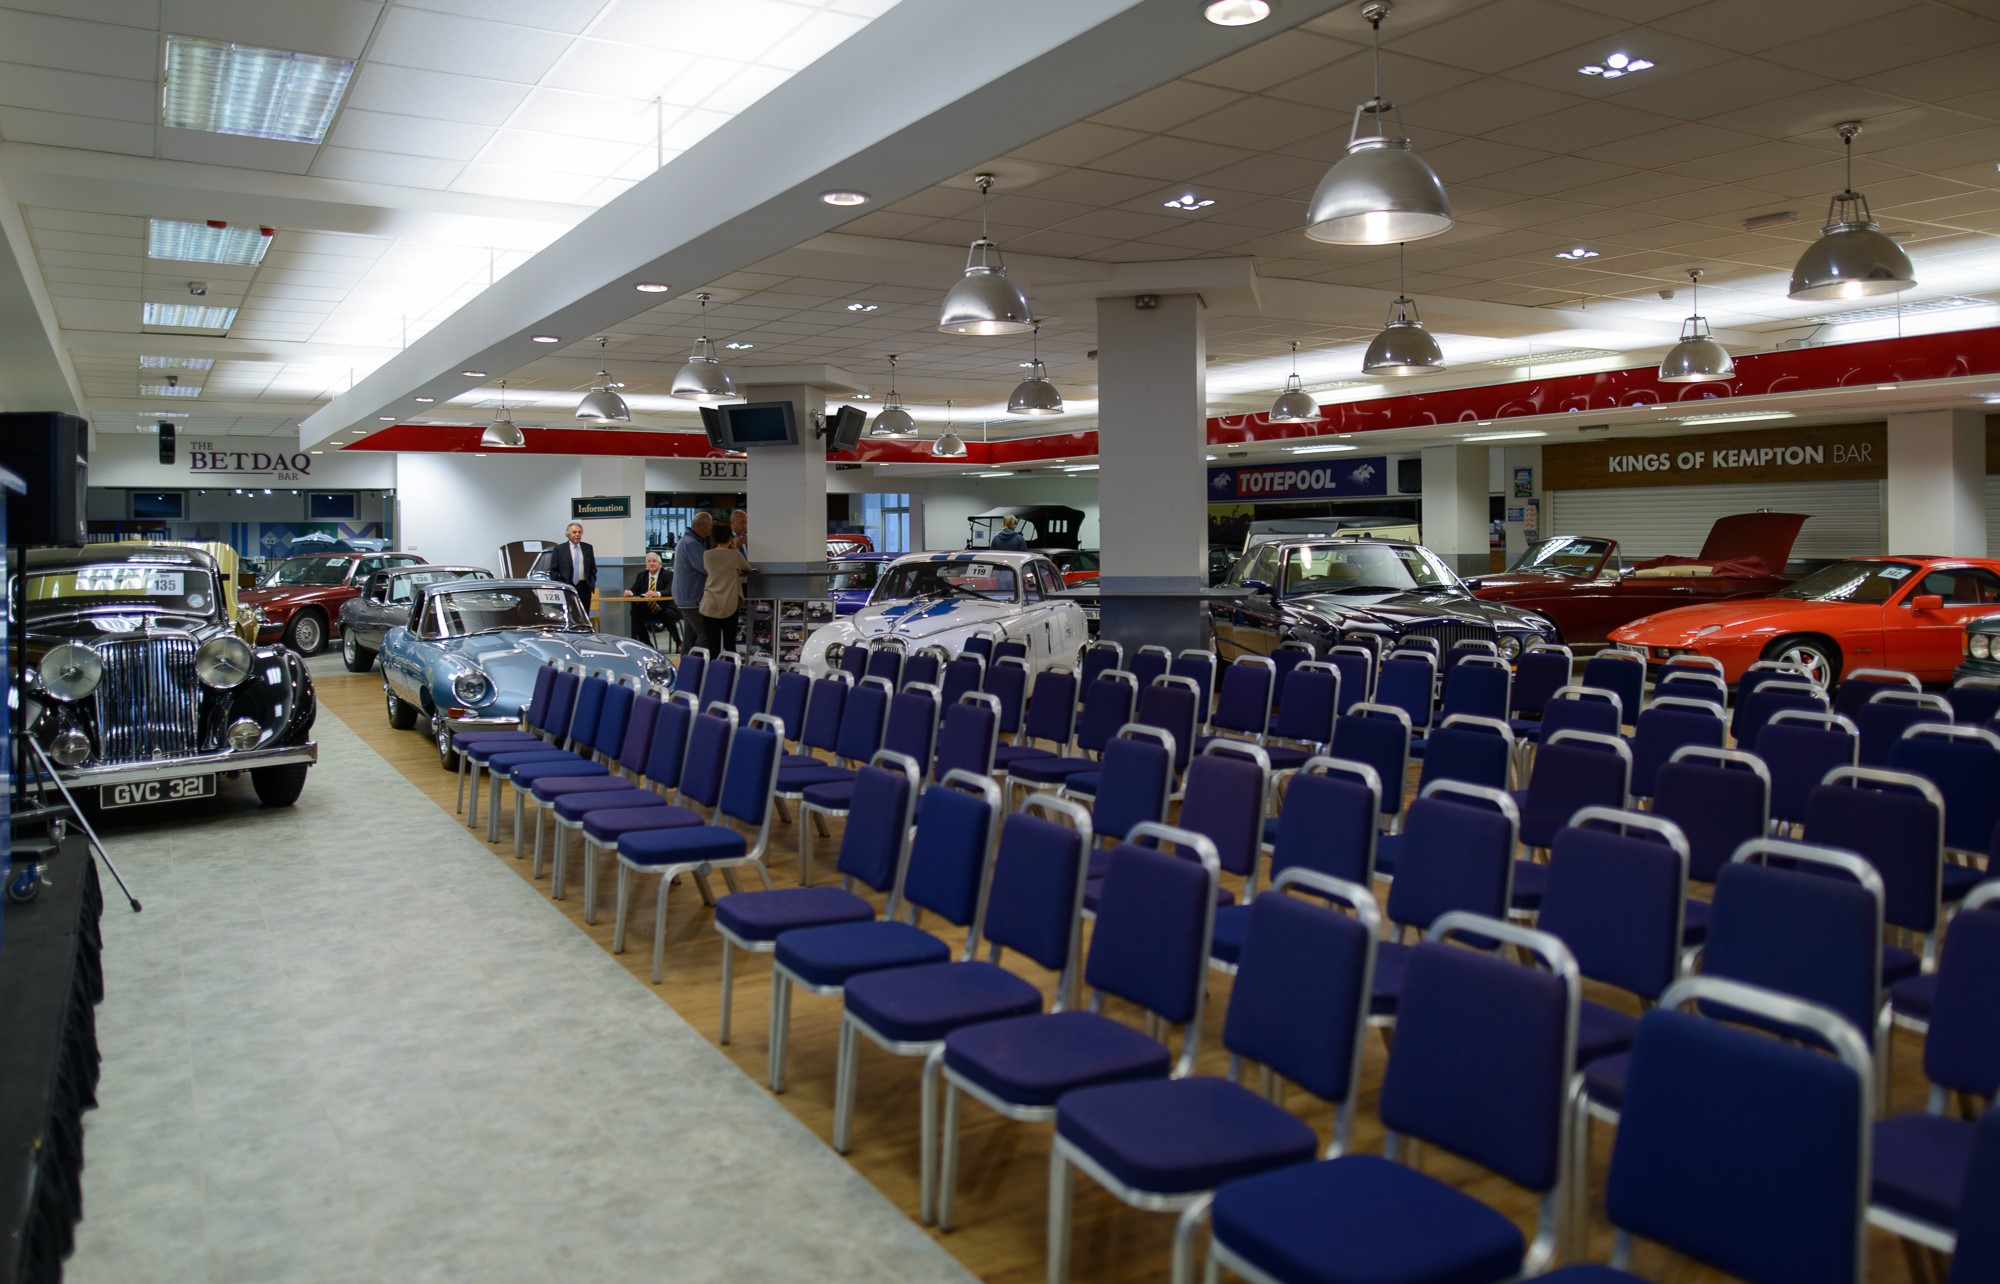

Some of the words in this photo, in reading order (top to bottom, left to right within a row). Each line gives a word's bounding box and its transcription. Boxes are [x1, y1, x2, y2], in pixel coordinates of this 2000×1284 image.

[190, 441, 213, 450] THE
[189, 451, 311, 475] BETDAQ
[1609, 453, 1671, 473] KINGS
[1677, 451, 1705, 470] OF
[1712, 445, 1824, 468] KEMPTON
[1833, 443, 1872, 463] BAR
[699, 461, 747, 478] BET
[278, 472, 299, 480] BAR
[1239, 468, 1336, 493] TOTEPOOL
[578, 503, 624, 513] Information
[972, 568, 987, 576] 119
[154, 580, 176, 591] 135
[544, 592, 561, 601] 128
[114, 782, 161, 805] GVC
[168, 776, 204, 799] 321
